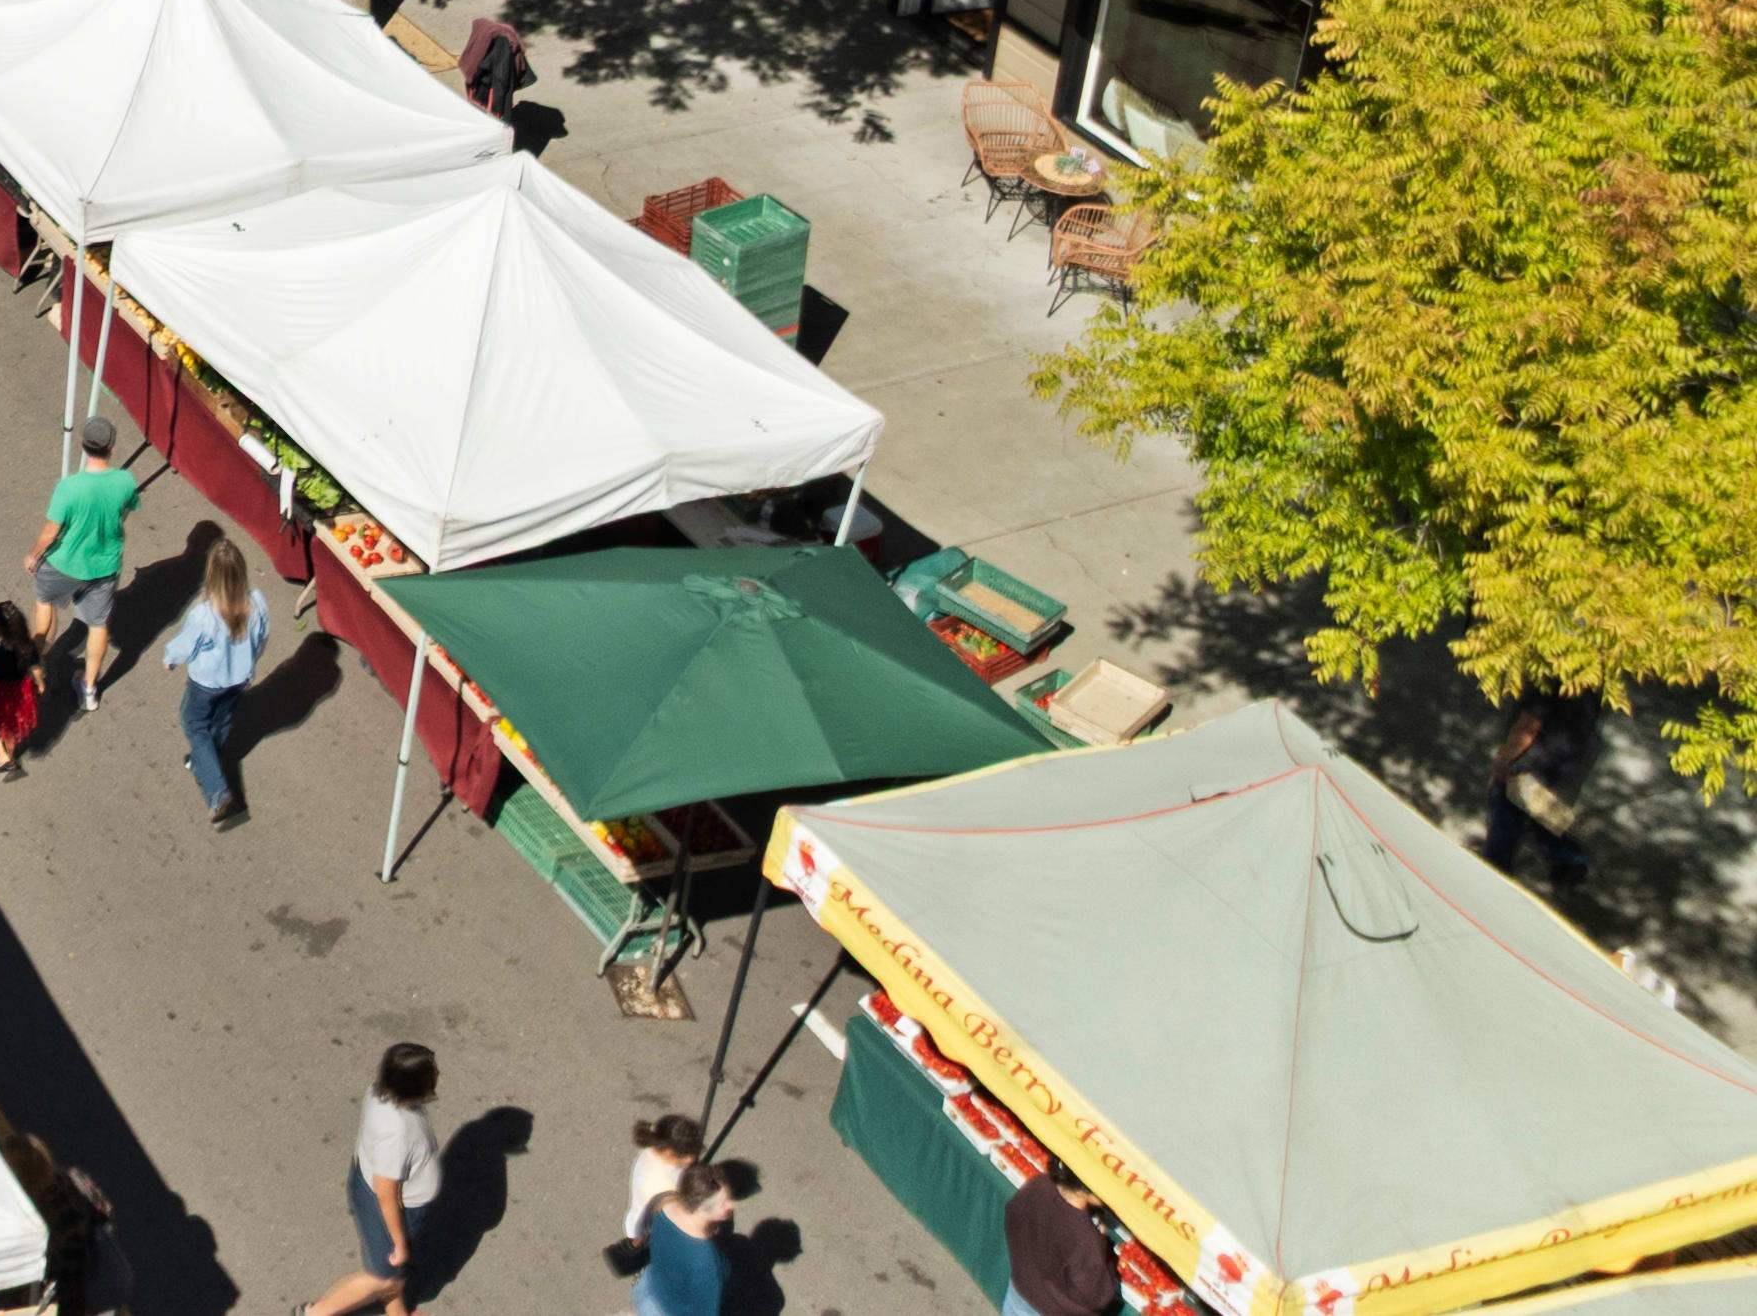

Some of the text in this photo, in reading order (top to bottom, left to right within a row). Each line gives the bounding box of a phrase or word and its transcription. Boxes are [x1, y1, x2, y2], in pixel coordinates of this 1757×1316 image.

[829, 880, 1198, 1243] Medina Berry Farms
